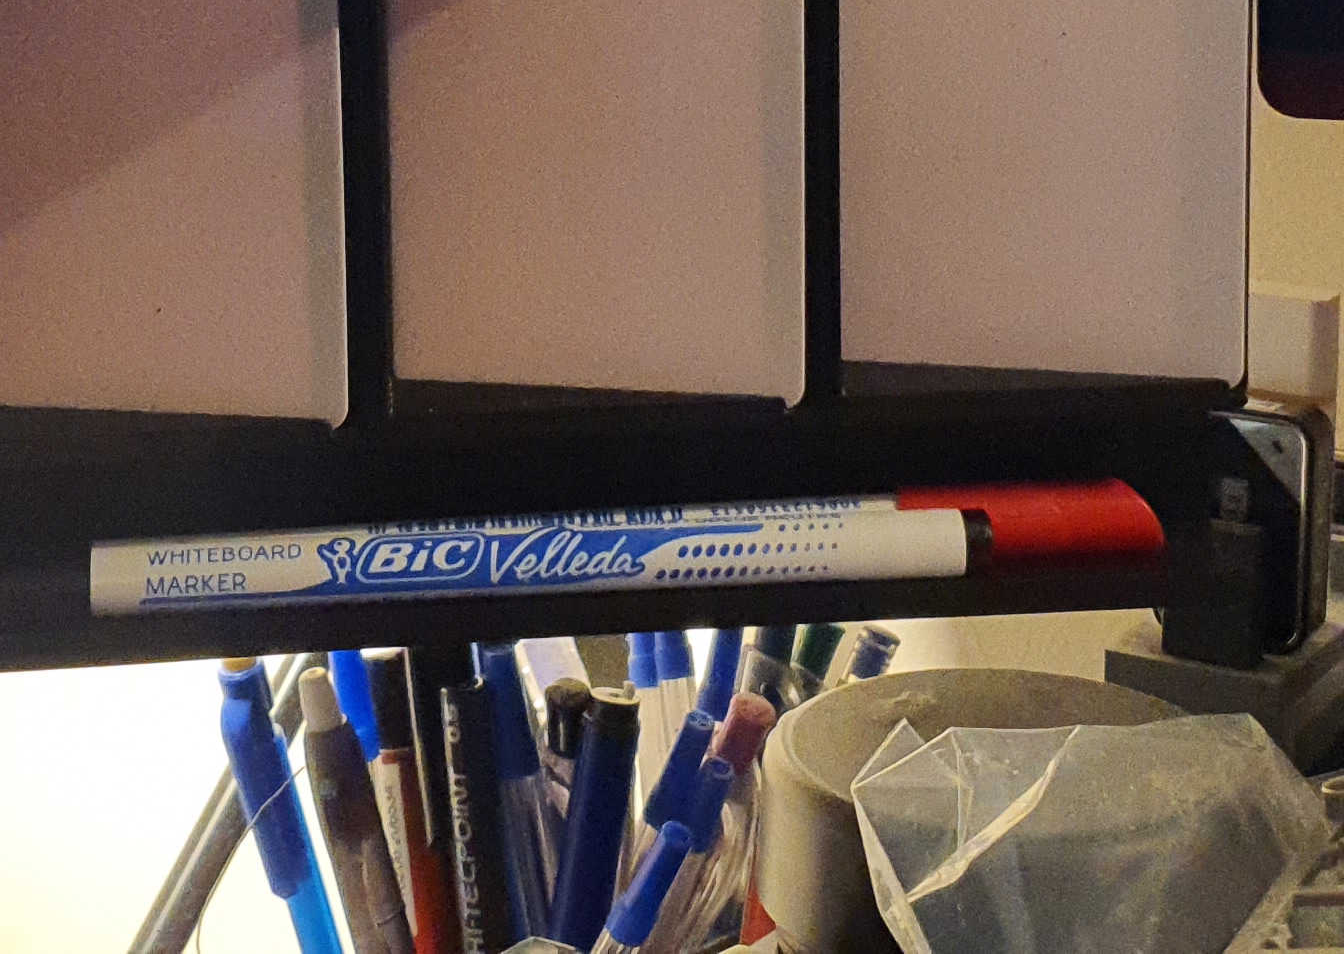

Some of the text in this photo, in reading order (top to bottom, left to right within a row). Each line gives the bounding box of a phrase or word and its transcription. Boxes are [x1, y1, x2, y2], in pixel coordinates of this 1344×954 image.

[148, 543, 302, 566] WHITEBOARD
[488, 527, 645, 587] Velleda
[145, 573, 248, 596] MARKER
